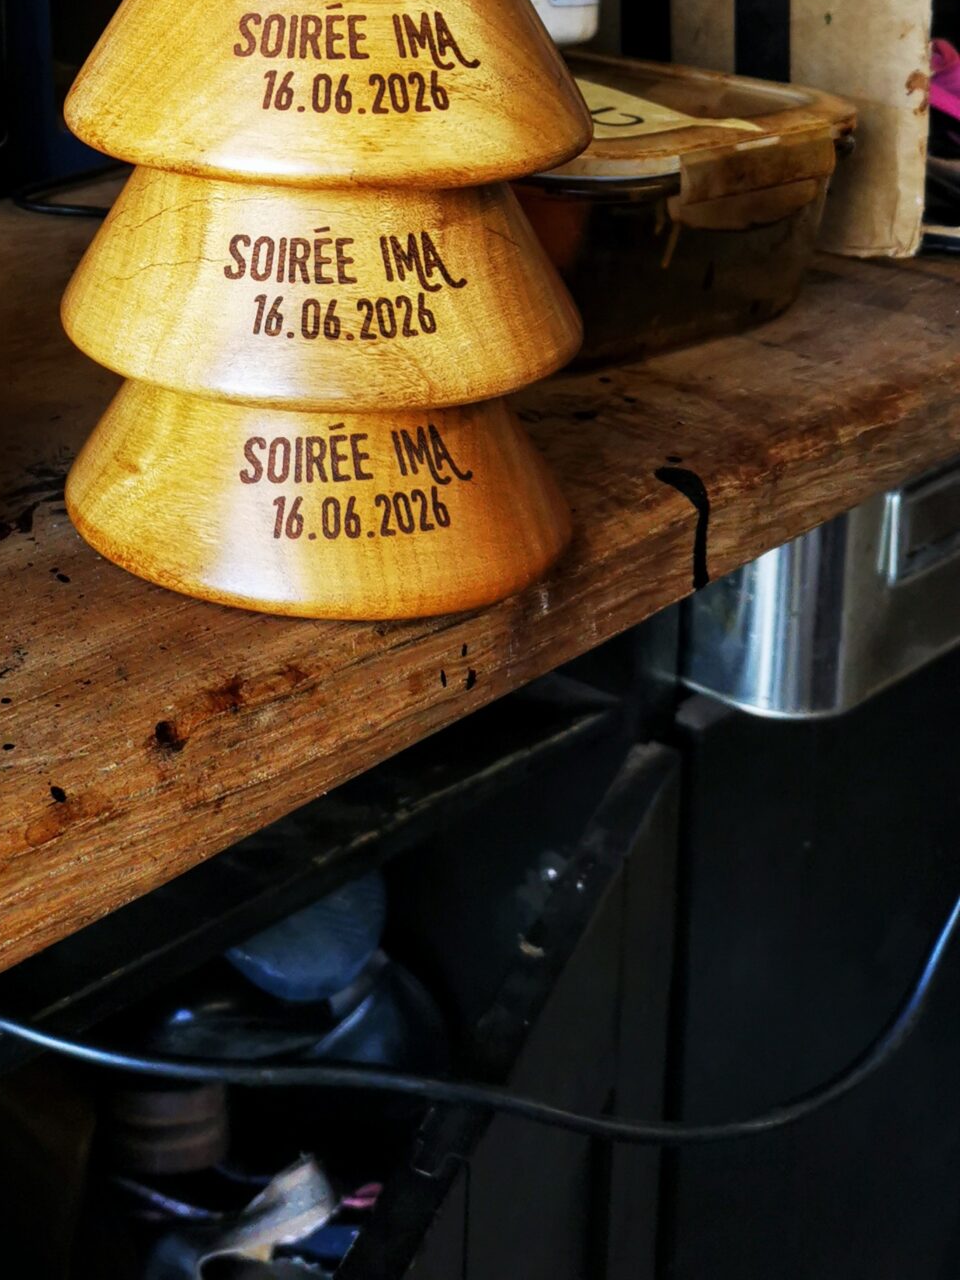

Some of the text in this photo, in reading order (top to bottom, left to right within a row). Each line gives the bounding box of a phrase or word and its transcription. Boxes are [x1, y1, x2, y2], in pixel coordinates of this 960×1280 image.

[234, 3, 480, 69] SOIRÉE IMA
[263, 70, 449, 114] 16.06.2026
[224, 227, 466, 291] SOIRÉE IMA
[253, 294, 436, 341] 16.06.2026
[240, 423, 472, 484] SOIRÉE IMA
[272, 486, 450, 539] 16.06.2026
